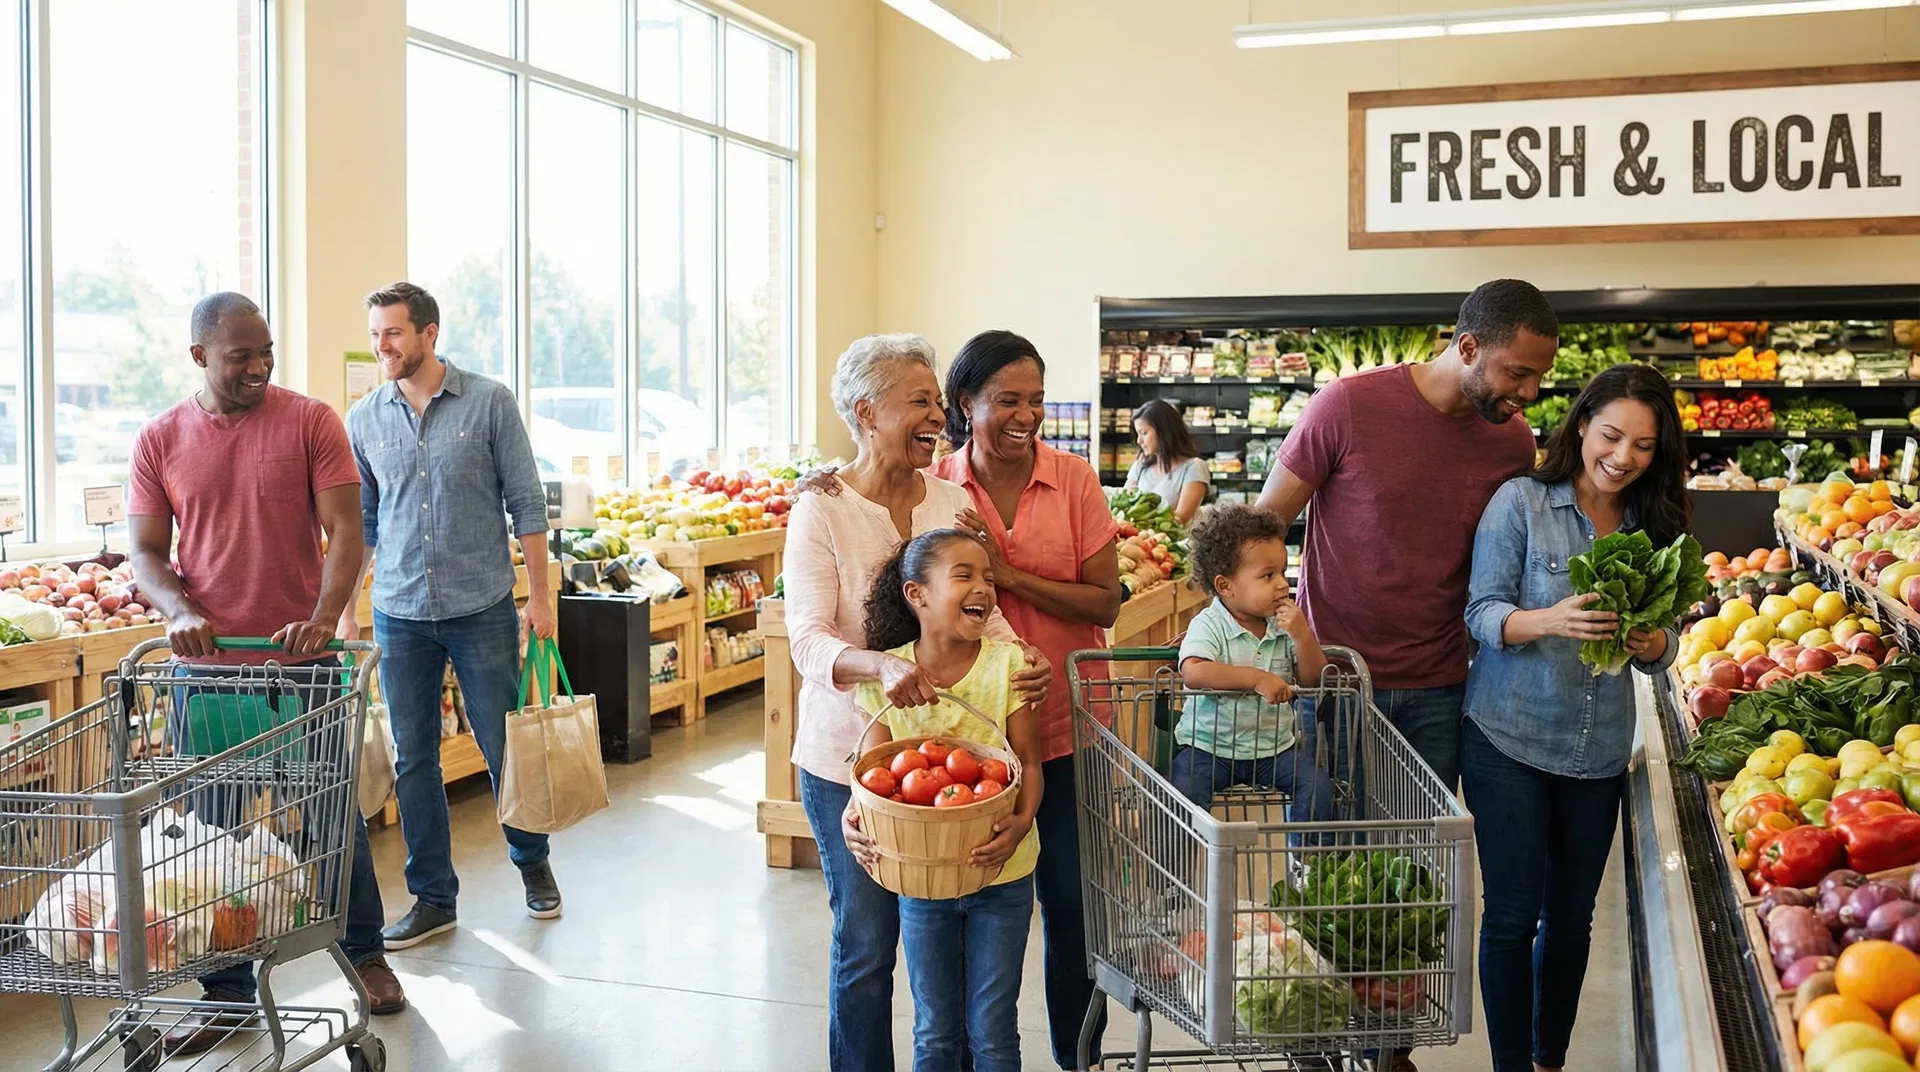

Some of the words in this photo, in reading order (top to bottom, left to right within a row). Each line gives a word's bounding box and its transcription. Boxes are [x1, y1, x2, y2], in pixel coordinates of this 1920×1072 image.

[1390, 124, 1586, 204] FRESH
[1613, 121, 1666, 197] &
[1692, 111, 1902, 194] LOCAL
